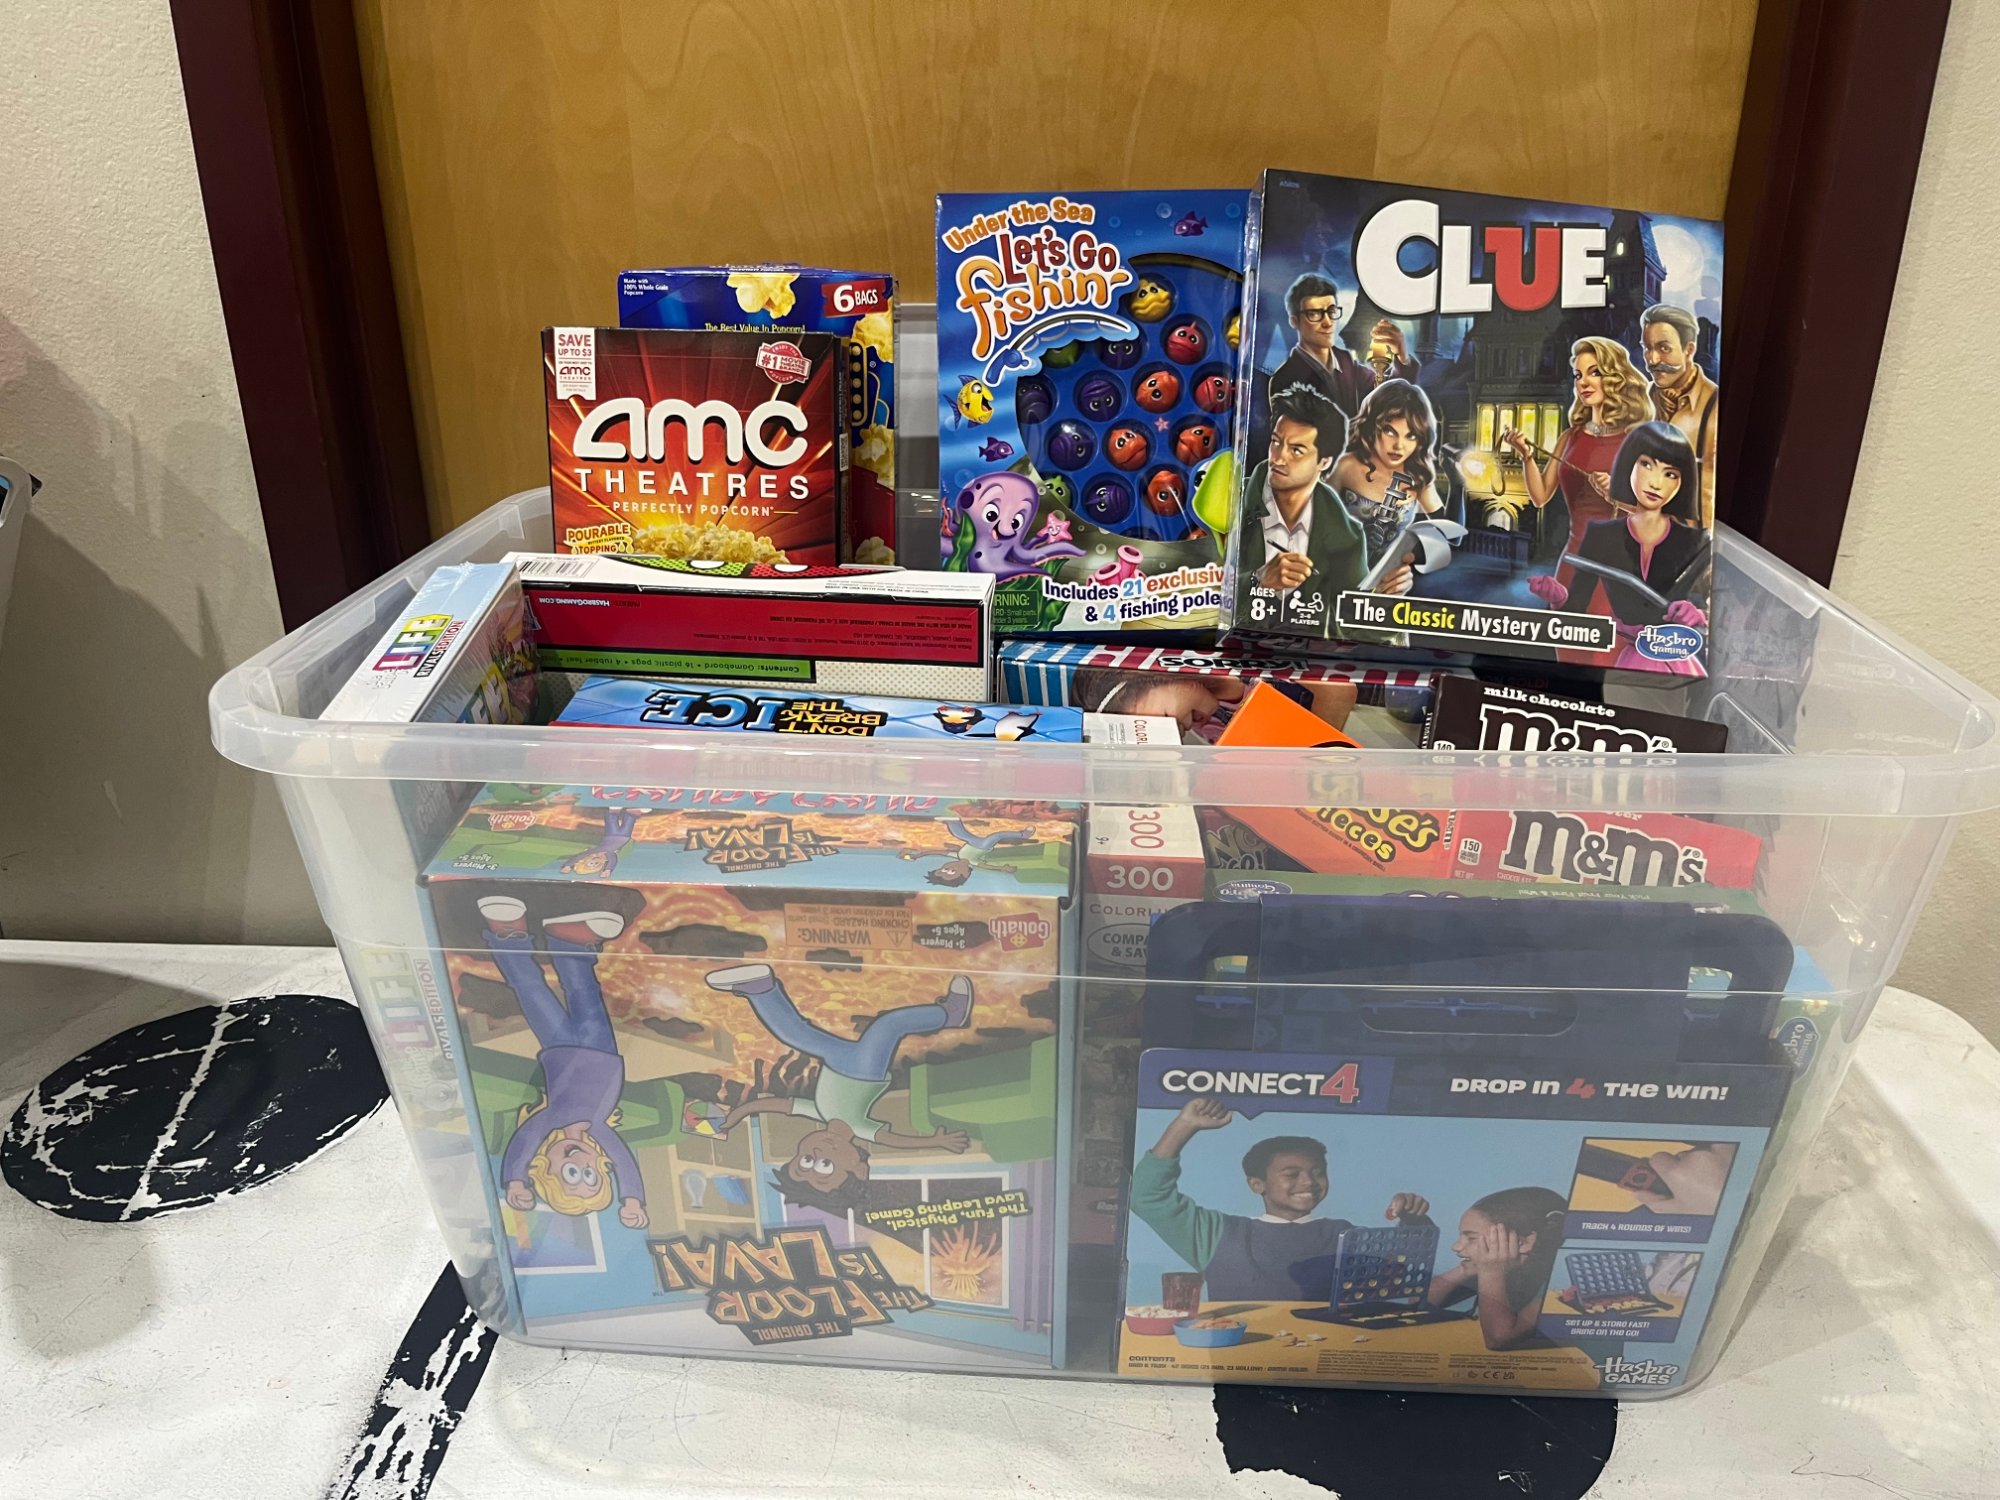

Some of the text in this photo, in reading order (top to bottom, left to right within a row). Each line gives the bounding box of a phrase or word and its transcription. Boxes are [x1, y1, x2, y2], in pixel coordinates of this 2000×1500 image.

[945, 199, 1093, 251] Under the Sea
[1000, 228, 1117, 284] Let's Go
[1355, 199, 1606, 315] CLUE
[833, 285, 878, 313] 6 BAGS
[705, 323, 718, 331] The
[720, 323, 736, 331] Best
[740, 323, 759, 332] Value
[558, 334, 592, 346] SAVE
[582, 348, 592, 357] $3
[762, 354, 778, 370] #1
[780, 356, 806, 366] MOVIE
[573, 468, 810, 500] THEATRES
[613, 501, 771, 517] PERFECTLY POPCORN
[568, 523, 629, 542] POURABLE
[579, 545, 617, 554] TOPPING
[1045, 566, 1223, 600] Includes 21 exclusiv
[995, 594, 1030, 606] RNING:
[1250, 587, 1275, 598] AGES
[1085, 590, 1221, 622] & 4 fishing pole
[1251, 598, 1277, 621] 8+
[1290, 618, 1320, 626] PLAYERS
[1353, 598, 1601, 644] The Classic Mystery Game
[376, 617, 450, 670] LIFE
[1644, 627, 1697, 648] Hasbro
[414, 620, 466, 678] RIVALS EDITION
[1650, 643, 1688, 657] Gaming
[566, 656, 583, 664] feet
[585, 656, 614, 665] rubber
[631, 658, 653, 667] pegs
[654, 658, 682, 669] plastic
[684, 661, 694, 669] 16
[704, 661, 756, 672] Gameboard
[1158, 655, 1309, 671] SORRY!
[758, 664, 800, 673] Contents:
[792, 701, 844, 712] THE
[1484, 687, 1616, 717] milk chocolate
[643, 691, 786, 730] ICE
[780, 710, 881, 725] BREAK
[779, 722, 868, 736] DON'T
[689, 823, 789, 850] LAVA!
[1128, 809, 1164, 849] 300
[707, 843, 838, 865] THE FLOOR
[1461, 850, 1478, 858] CALORIES
[1463, 840, 1480, 852] 150
[453, 862, 486, 870] Players
[726, 863, 763, 872] ORIGINAL
[1106, 865, 1173, 891] 300
[871, 916, 910, 928] CHOKING
[992, 919, 1049, 940] Goliath
[798, 928, 871, 945] WARNING:
[946, 927, 965, 938] Ages
[1102, 933, 1148, 946] COMPA
[921, 937, 953, 949] Players
[1111, 947, 1121, 958] &
[414, 959, 454, 1060] RIVALS EDITION
[1450, 1078, 1526, 1095] DROP
[1566, 1077, 1596, 1097] 4
[865, 1192, 1024, 1224] Lava Leaping Game!
[886, 1203, 1028, 1231] The Fun, Physical,
[1581, 1222, 1608, 1230] TRACK
[654, 1230, 837, 1288] LAVA!
[714, 1280, 929, 1324] THE FLOOR
[752, 1321, 843, 1341] THE ORIGINAL
[1628, 1321, 1650, 1329] FAST!
[1594, 1357, 1678, 1375] Hasbro
[1605, 1374, 1672, 1384] GAMES
